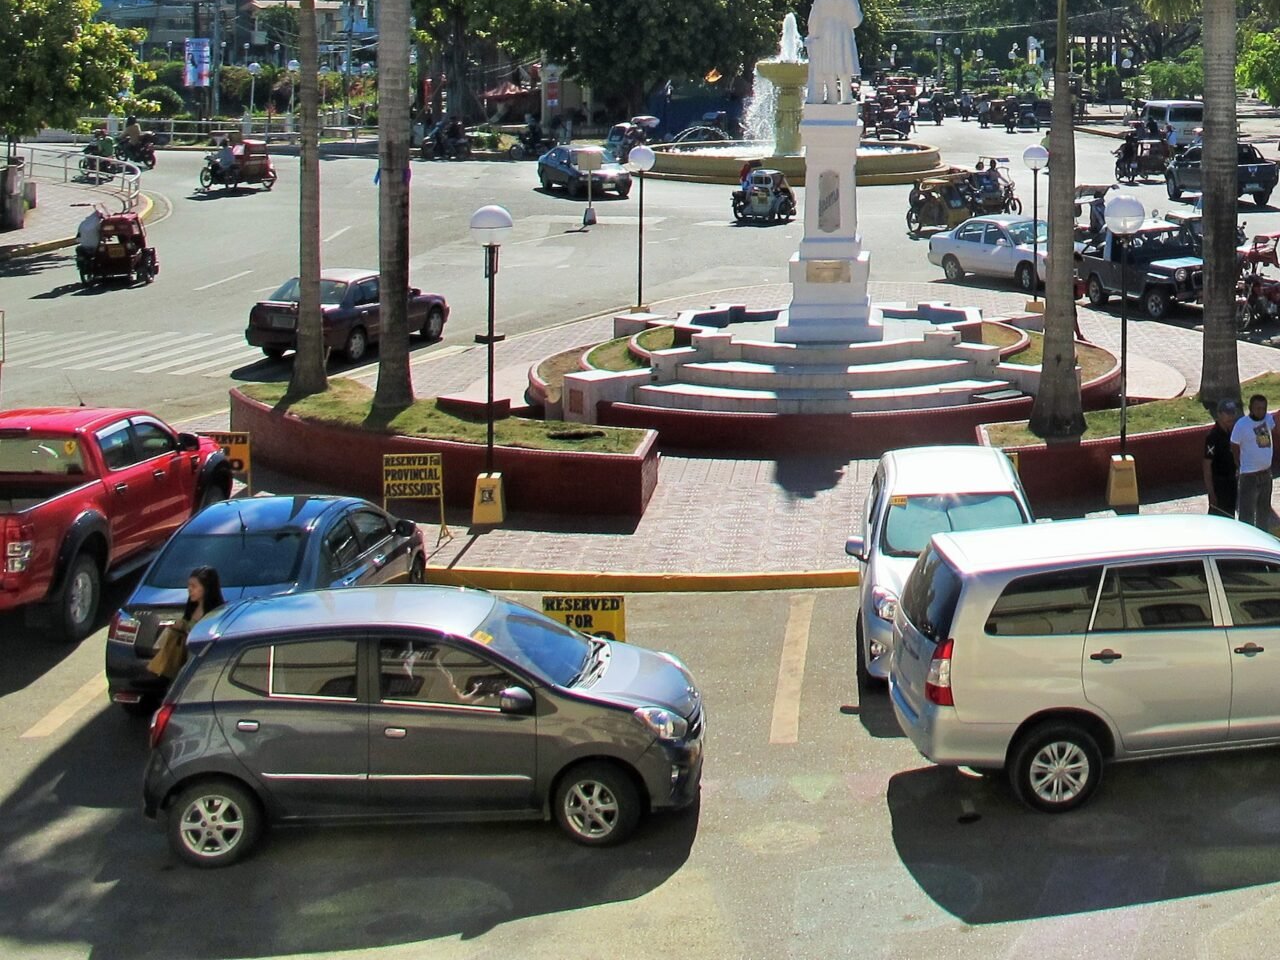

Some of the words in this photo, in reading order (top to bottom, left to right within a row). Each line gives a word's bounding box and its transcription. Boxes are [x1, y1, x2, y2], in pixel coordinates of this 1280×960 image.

[384, 456, 428, 466] RESERVED
[384, 468, 440, 481] PROVINCIAL
[544, 597, 621, 611] RESERVED
[565, 614, 593, 628] FOR
